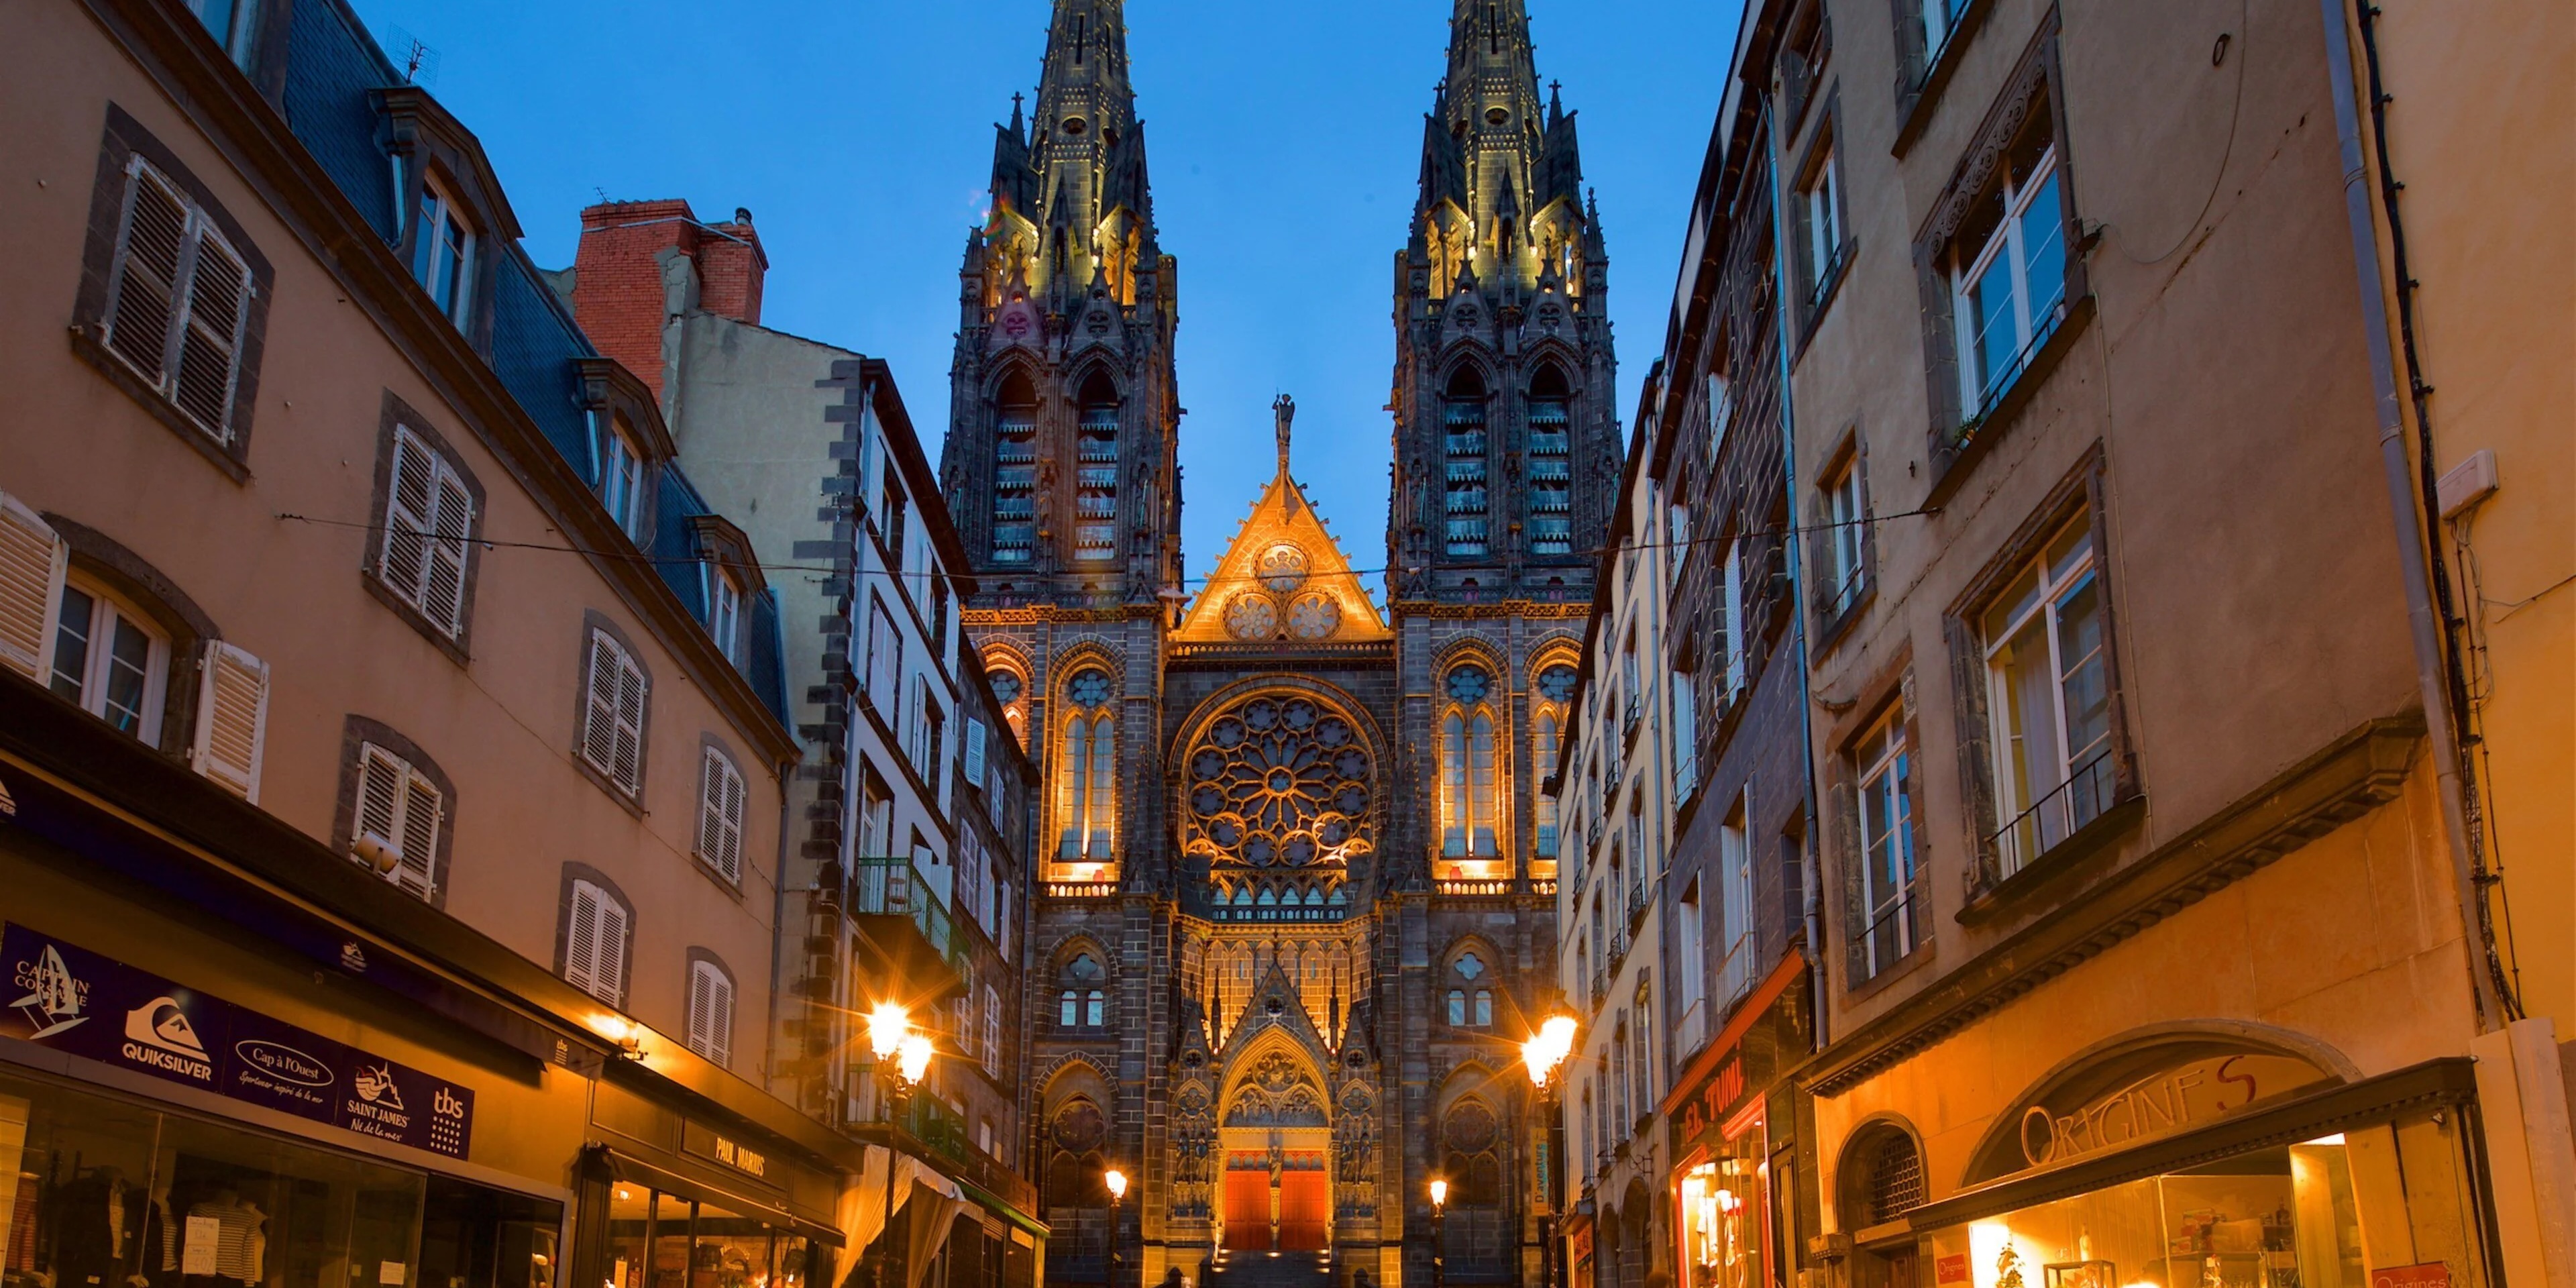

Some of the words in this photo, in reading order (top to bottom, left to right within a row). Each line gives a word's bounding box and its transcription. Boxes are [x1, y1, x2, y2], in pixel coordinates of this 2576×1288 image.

[16, 961, 90, 994] CAPTAIN
[122, 1042, 211, 1081] QUIKSILVER
[253, 1048, 274, 1067] Cap
[276, 1055, 283, 1068] à
[285, 1057, 319, 1079] l'Ouest
[347, 1099, 378, 1119] SAINT
[377, 1109, 408, 1128] JAMES
[434, 1087, 464, 1119] tbs
[363, 1123, 374, 1134] de
[1686, 1101, 1705, 1143] EL
[716, 1137, 734, 1165] PAUL
[737, 1146, 764, 1177] MARIUS
